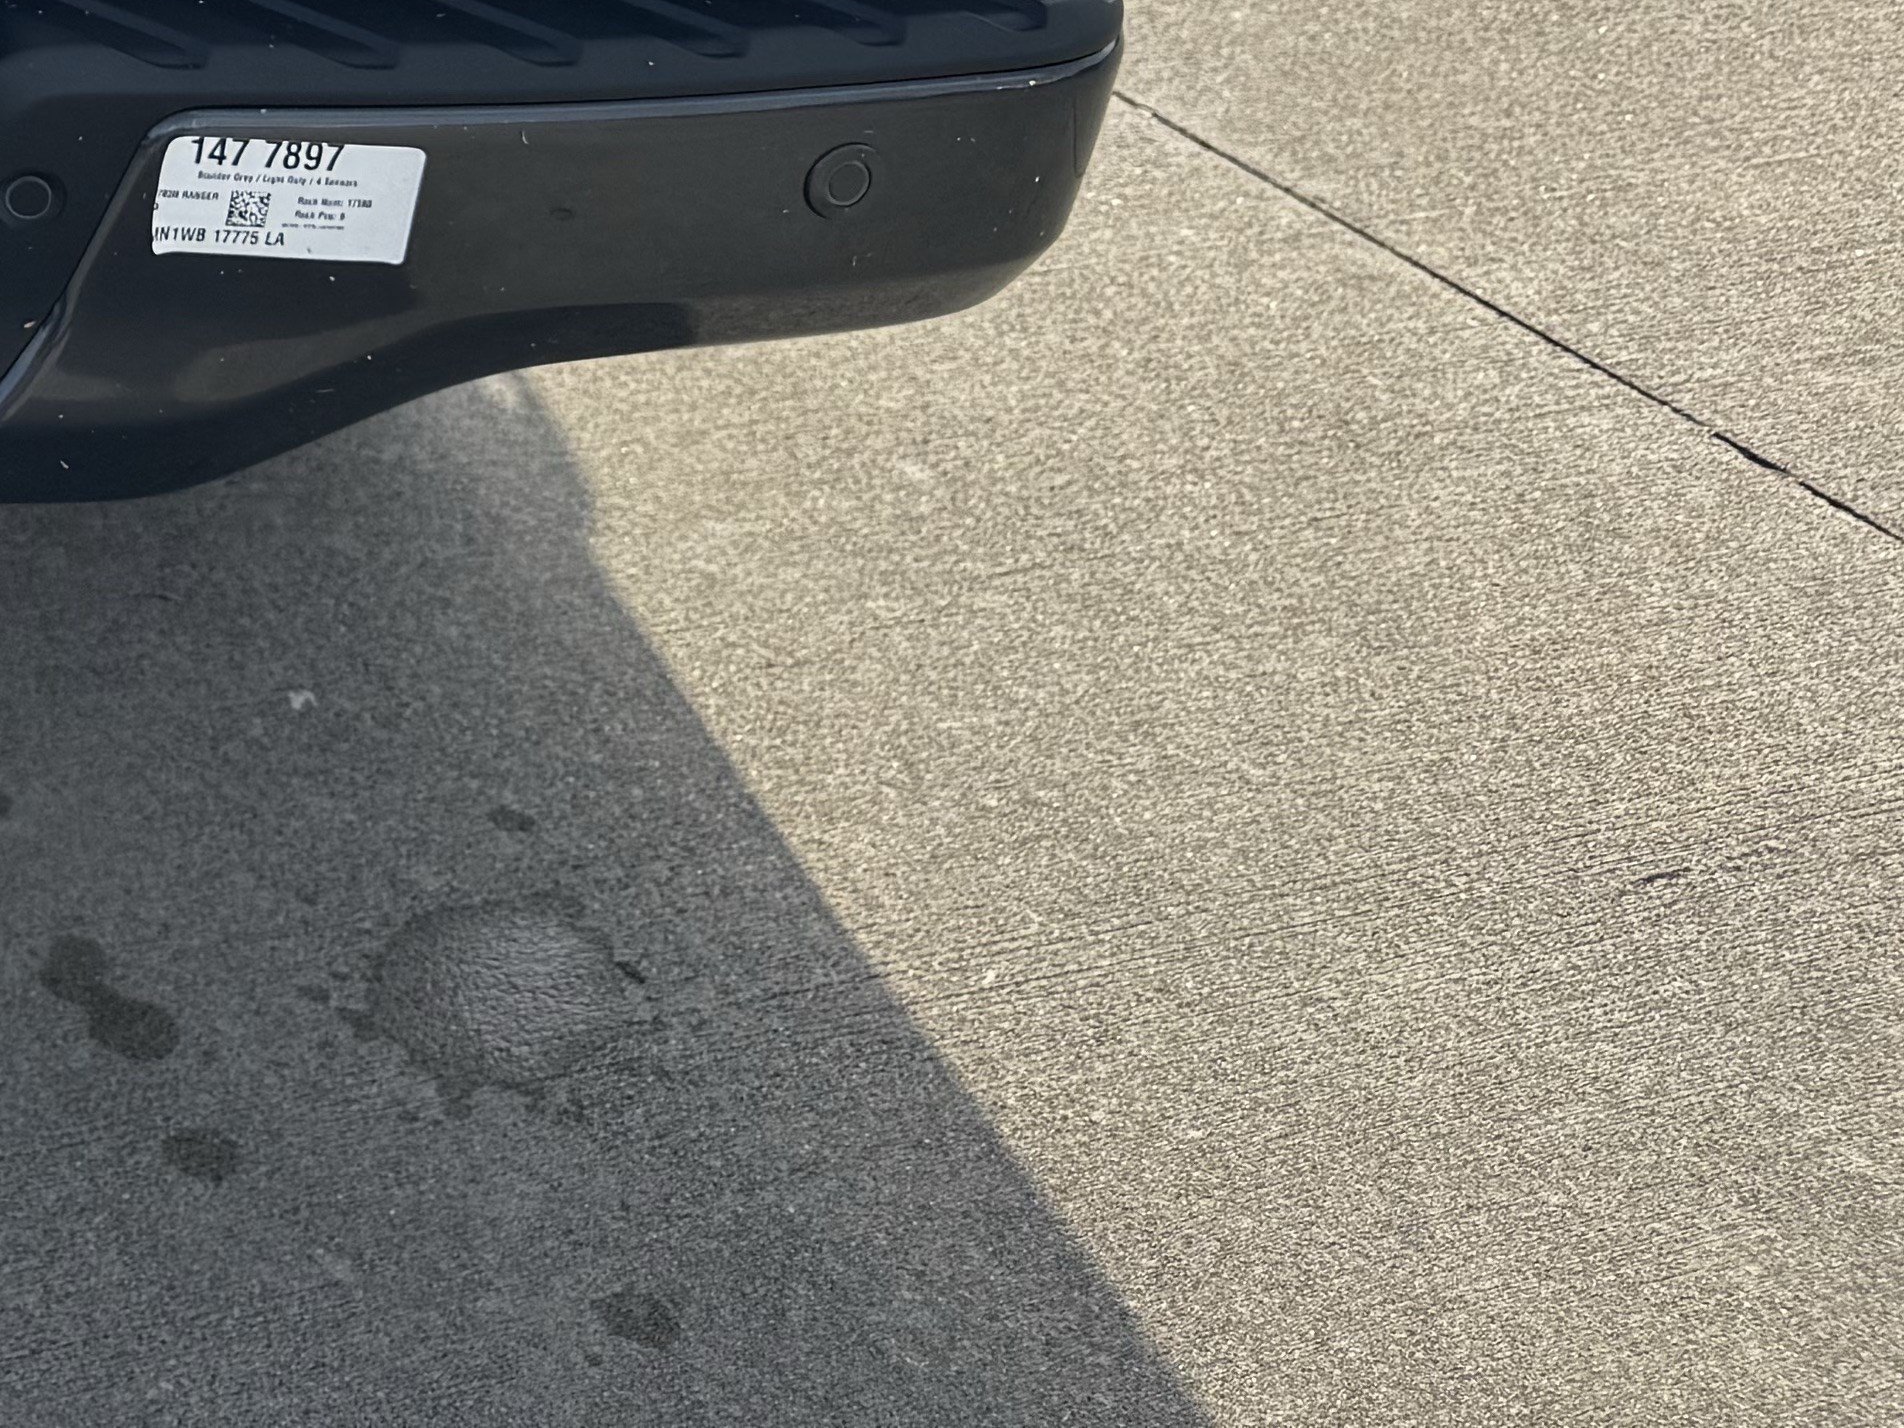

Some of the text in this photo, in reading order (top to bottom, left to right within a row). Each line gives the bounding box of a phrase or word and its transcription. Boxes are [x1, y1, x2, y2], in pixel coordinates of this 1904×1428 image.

[191, 136, 345, 171] 147 7897
[214, 229, 259, 245] 17775
[264, 232, 285, 246] LA
